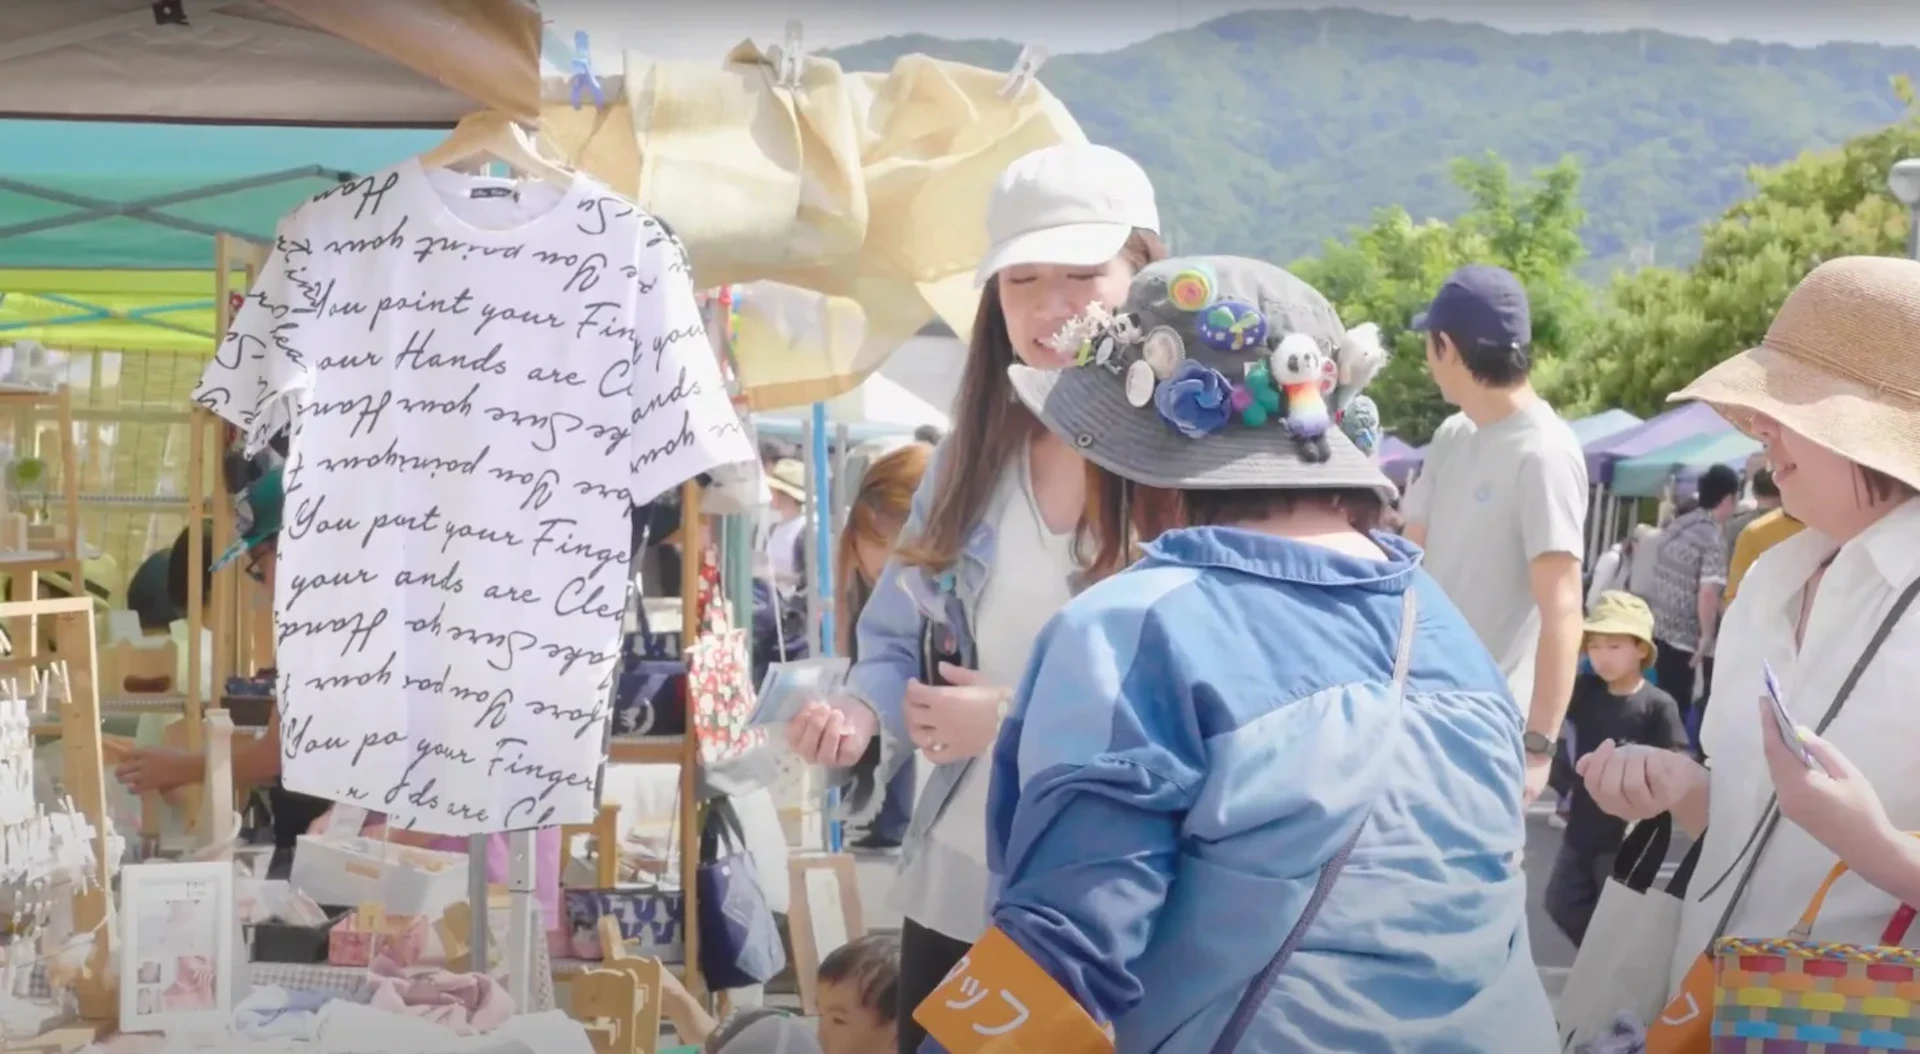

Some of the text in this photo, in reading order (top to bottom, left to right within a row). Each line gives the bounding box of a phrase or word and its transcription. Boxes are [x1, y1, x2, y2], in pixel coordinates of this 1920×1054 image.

[412, 237, 526, 263] point
[370, 288, 474, 331] point
[477, 301, 566, 336] your
[316, 351, 384, 371] our
[396, 331, 507, 374] Hands
[527, 366, 586, 385] are
[397, 383, 480, 418] your
[485, 405, 583, 450] Sure
[487, 467, 560, 510] You
[289, 495, 360, 540] You
[441, 521, 523, 554] your
[286, 569, 378, 611] your
[484, 586, 541, 603] are
[447, 626, 536, 671] Sure
[305, 651, 397, 693] your
[449, 686, 513, 729] You
